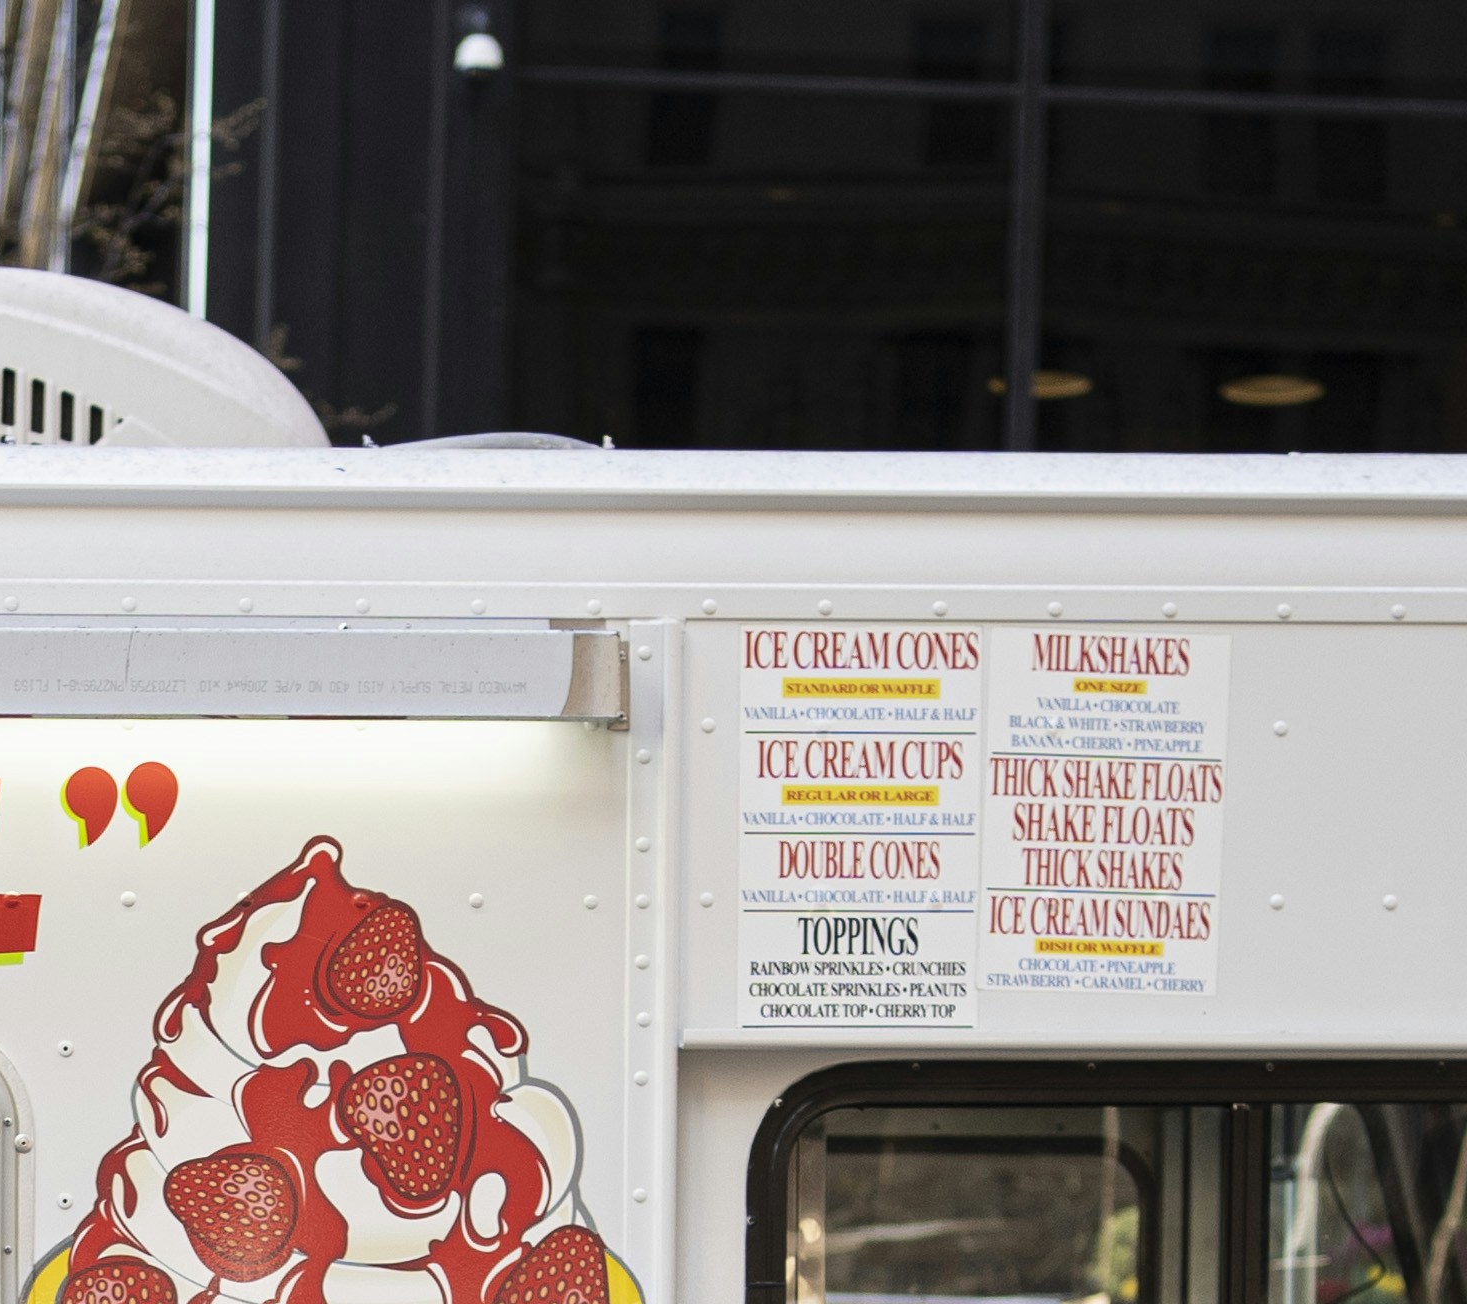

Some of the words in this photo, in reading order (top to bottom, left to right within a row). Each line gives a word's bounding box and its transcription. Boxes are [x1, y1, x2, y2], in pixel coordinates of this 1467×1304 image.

[745, 631, 788, 669] ICE
[793, 631, 890, 669] CREAM
[897, 632, 979, 670] CONES
[1032, 633, 1190, 676] MILKSHAKES
[787, 683, 857, 693] STANDARD
[860, 684, 876, 693] OR
[883, 684, 935, 694] WAFFLE
[1075, 682, 1106, 692] ONE
[1110, 683, 1143, 692] SIZE
[745, 707, 797, 720] VANILLA
[806, 707, 885, 720] CHOCOLATE
[895, 708, 928, 720] HALF
[931, 708, 940, 720] &
[944, 709, 977, 720] HALF
[1037, 697, 1091, 711] VANILLA
[1100, 699, 1179, 714] CHOCOLATE
[1010, 715, 1055, 729] BLACK
[1056, 718, 1064, 729] &
[1069, 717, 1111, 731] WHITE
[1120, 719, 1206, 734] STRAWBERRY
[1011, 735, 1064, 748] BANANA
[1072, 736, 1124, 750] CHERRY
[1134, 739, 1202, 752] PINEAPPLE
[758, 740, 798, 778] ICE
[805, 741, 896, 779] CREAM
[902, 741, 963, 779] CUPS
[991, 758, 1058, 796] THICK
[1063, 759, 1136, 800] SHAKE
[1142, 763, 1222, 803] FLOATS
[787, 790, 856, 801] REGULAR
[860, 791, 877, 801] OR
[884, 791, 934, 801] LARGE
[743, 812, 796, 825] VANILLA
[805, 813, 884, 825] CHOCOLATE
[894, 813, 927, 825] HALF
[929, 813, 938, 825] &
[942, 814, 975, 826] HALF
[1013, 803, 1096, 842] SHAKE
[1103, 805, 1195, 846] FLOATS
[779, 841, 865, 878] DOUBLE
[870, 842, 940, 879] CONES
[1023, 848, 1091, 887] THICK
[1097, 849, 1183, 890] SHAKES
[742, 890, 796, 902] VANILLA
[805, 890, 884, 902] CHOCOLATE
[894, 891, 927, 903] HALF
[929, 891, 938, 903] &
[943, 891, 976, 903] HALF
[989, 896, 1025, 934] ICE
[1031, 897, 1108, 936] CREAM
[1114, 899, 1210, 941] SUNDAES
[798, 917, 919, 955] TOPPINGS
[1039, 942, 1072, 951] DISH
[1075, 943, 1098, 952] OR
[1101, 943, 1159, 954] WAFFLE
[750, 962, 811, 976] RAINBOW
[814, 962, 884, 976] SPRINKLES
[893, 962, 966, 976] CRUNCHIES
[1019, 959, 1097, 972] CHOCOLATE
[1107, 960, 1175, 974] PINEAPPLE
[749, 983, 828, 997] CHOCOLATE
[831, 983, 900, 997] SPRINKLES
[910, 983, 967, 997] PEANUTS
[987, 974, 1072, 988] STRAWBERRY
[1082, 976, 1146, 990] CARAMEL
[1154, 978, 1206, 992] CHERRY
[761, 1004, 839, 1018] CHOCOLATE
[843, 1004, 867, 1018] TOP
[876, 1004, 926, 1018] CHERRY
[932, 1005, 956, 1018] TOP
